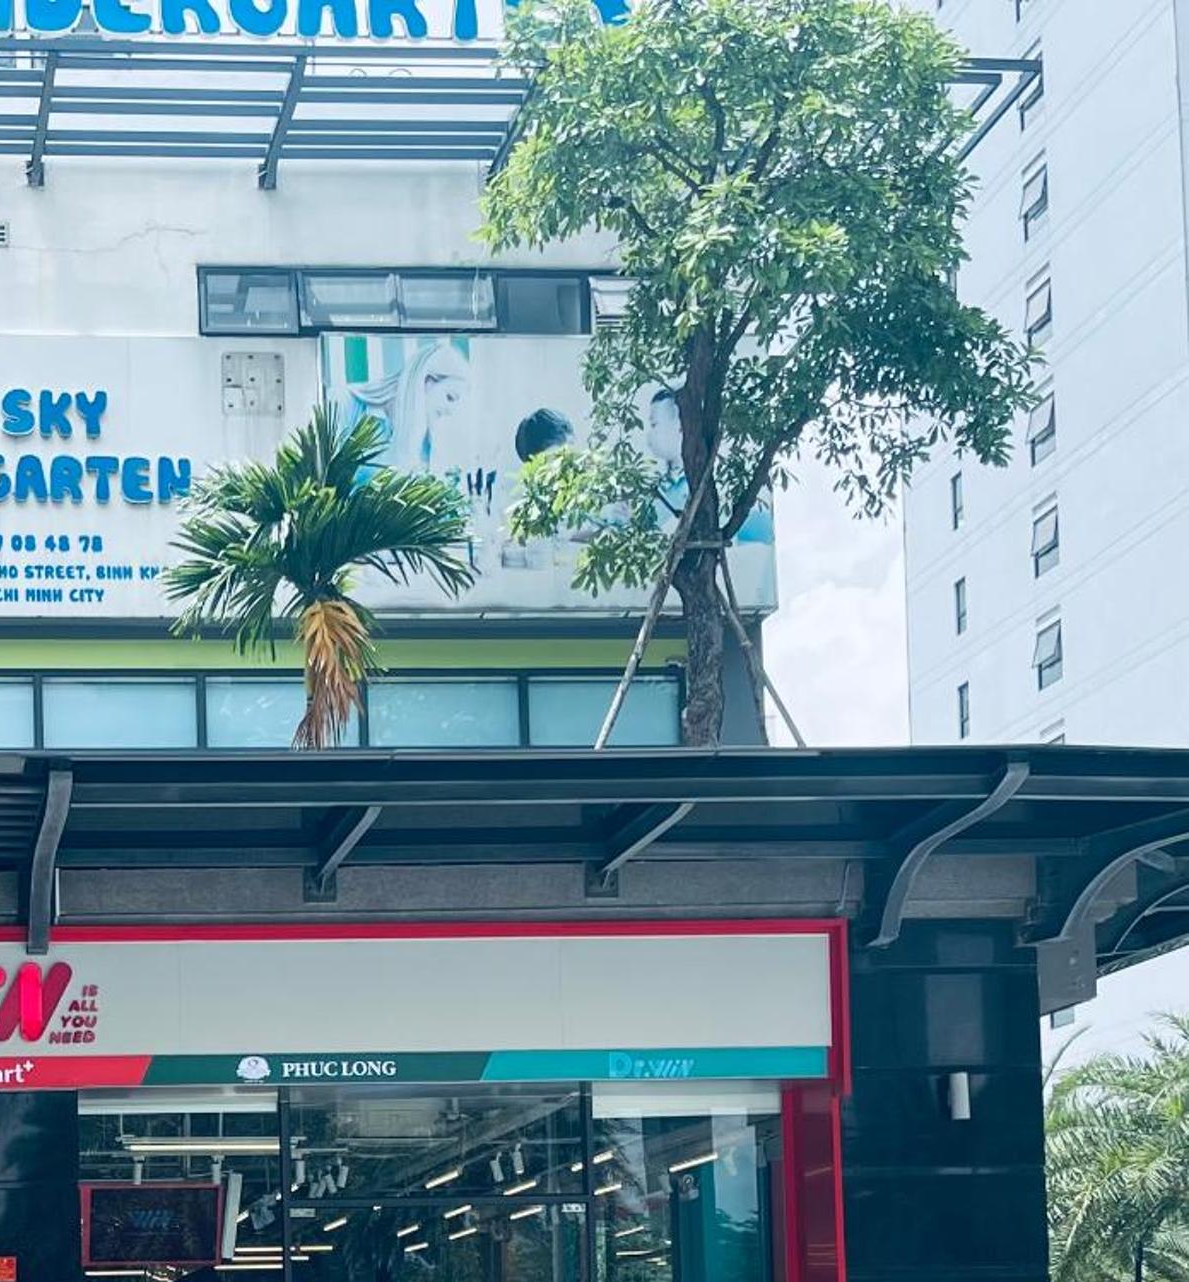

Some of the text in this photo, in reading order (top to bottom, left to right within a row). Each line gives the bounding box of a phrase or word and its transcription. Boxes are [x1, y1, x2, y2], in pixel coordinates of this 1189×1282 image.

[1, 389, 108, 439] SKY
[11, 534, 37, 551] 08
[44, 535, 70, 552] 48
[78, 535, 104, 552] 78
[24, 565, 91, 580] STREET,
[96, 566, 132, 580] BINH
[25, 588, 63, 602] MINH
[69, 588, 104, 603] CITY
[83, 984, 99, 997] IS
[68, 1001, 99, 1012] ALL
[61, 1015, 97, 1028] YOU
[48, 1030, 97, 1044] NEED
[341, 1061, 396, 1076] LONG
